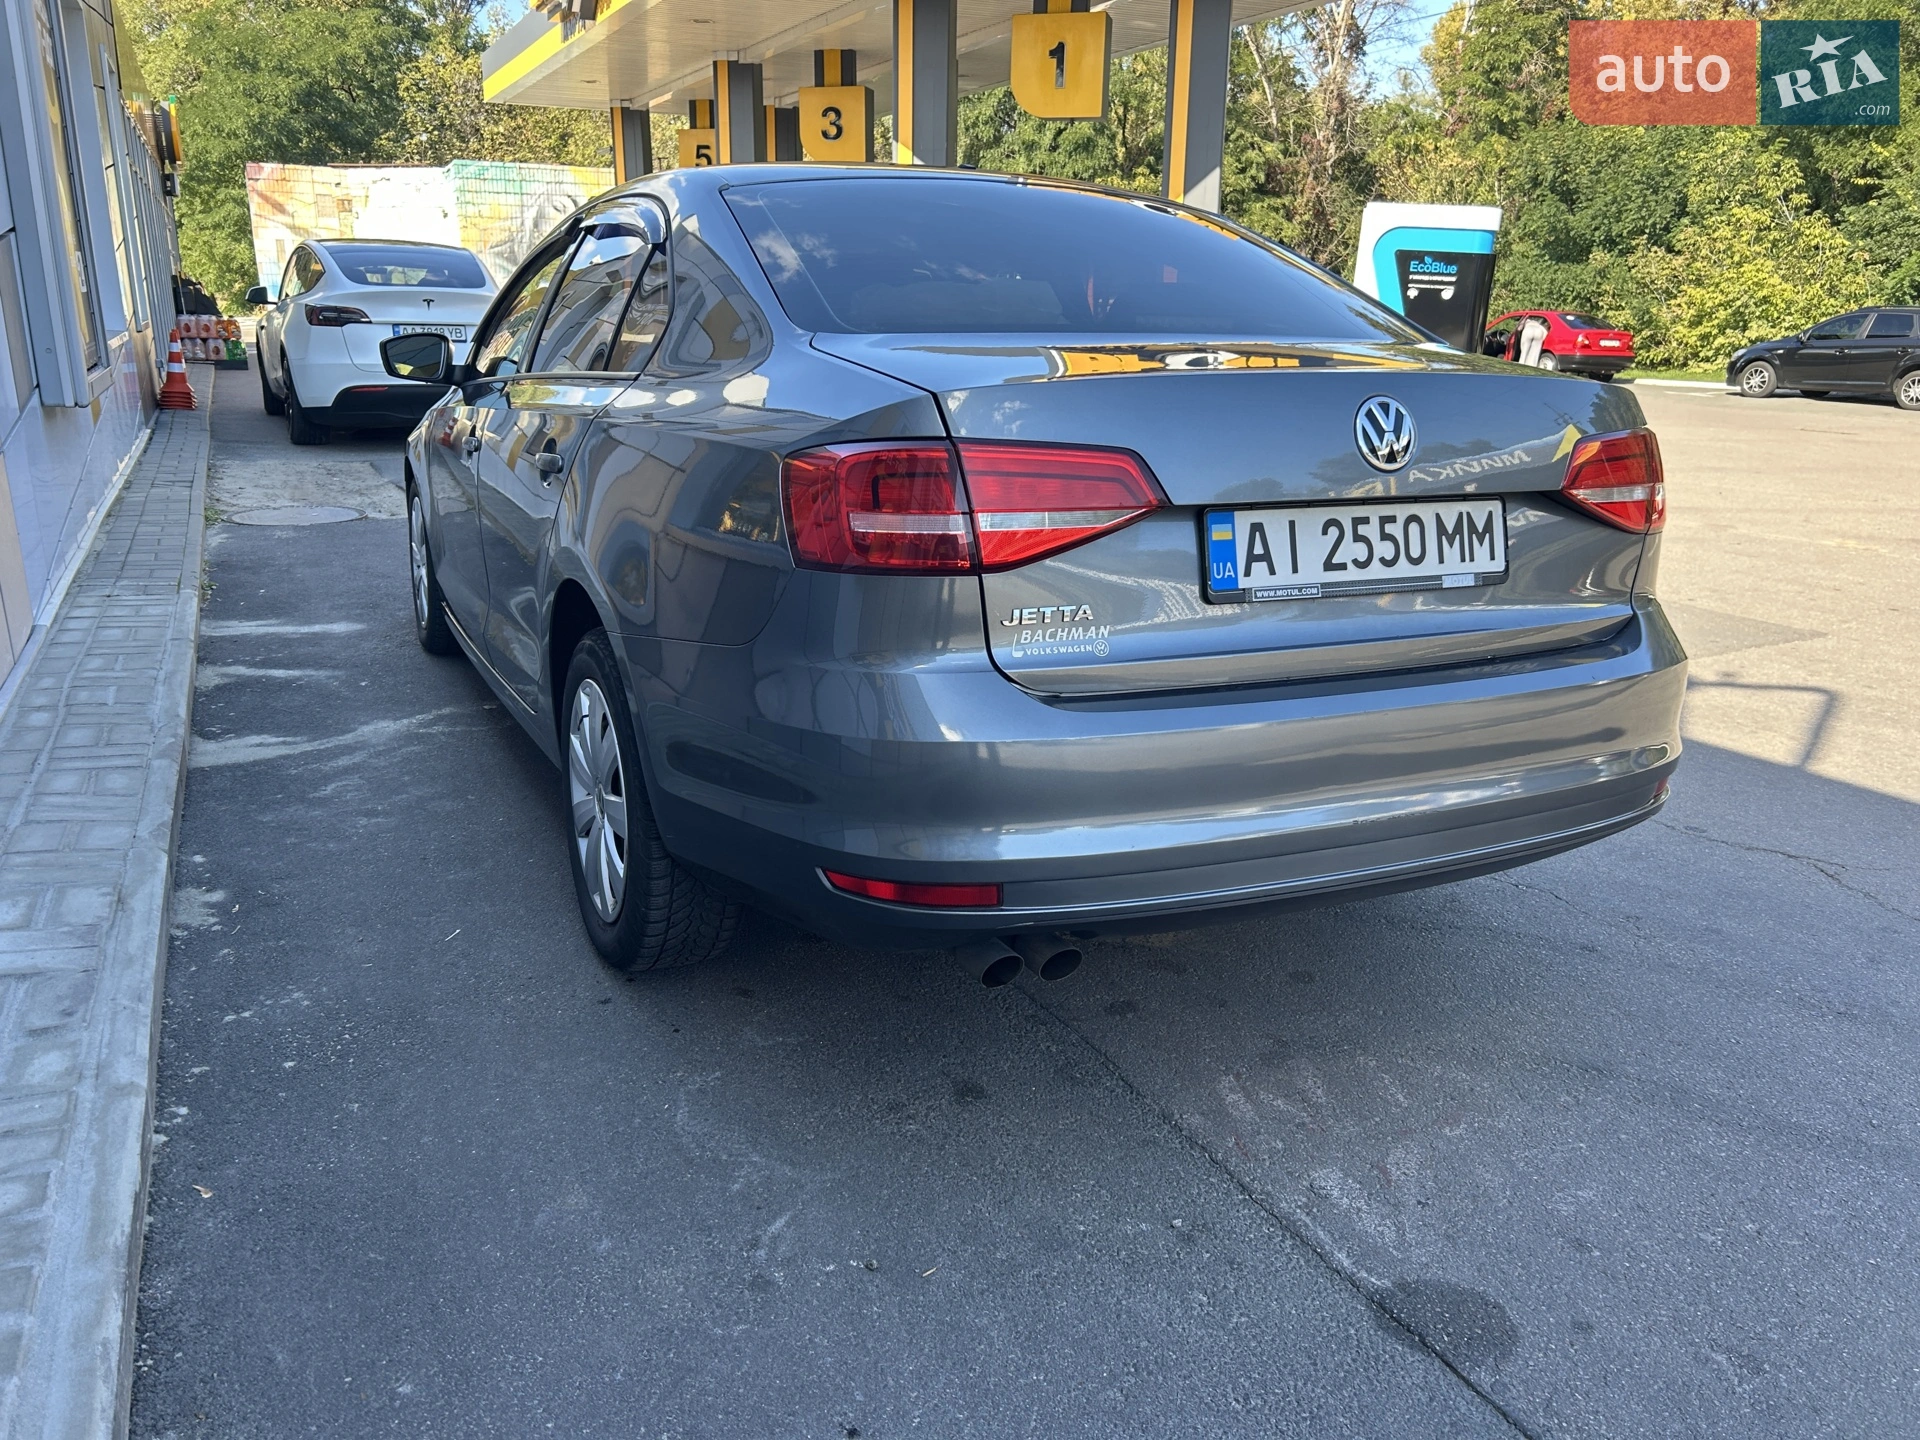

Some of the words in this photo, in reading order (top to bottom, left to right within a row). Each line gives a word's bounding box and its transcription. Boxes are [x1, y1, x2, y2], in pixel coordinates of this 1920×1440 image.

[1048, 41, 1067, 89] 1
[821, 106, 844, 141] 3
[695, 144, 712, 167] 5
[1409, 260, 1458, 274] EcoBlue
[447, 327, 463, 339] YB
[1243, 519, 1299, 578] AI
[1321, 513, 1426, 572] 2550
[1435, 510, 1495, 565] MM
[1213, 562, 1235, 579] UA
[1255, 587, 1318, 598] WWW.MOTUL.COM
[1000, 604, 1094, 627] JETTA
[1020, 625, 1110, 644] BACHMAN
[1025, 643, 1093, 655] VOLKSWAGEN
